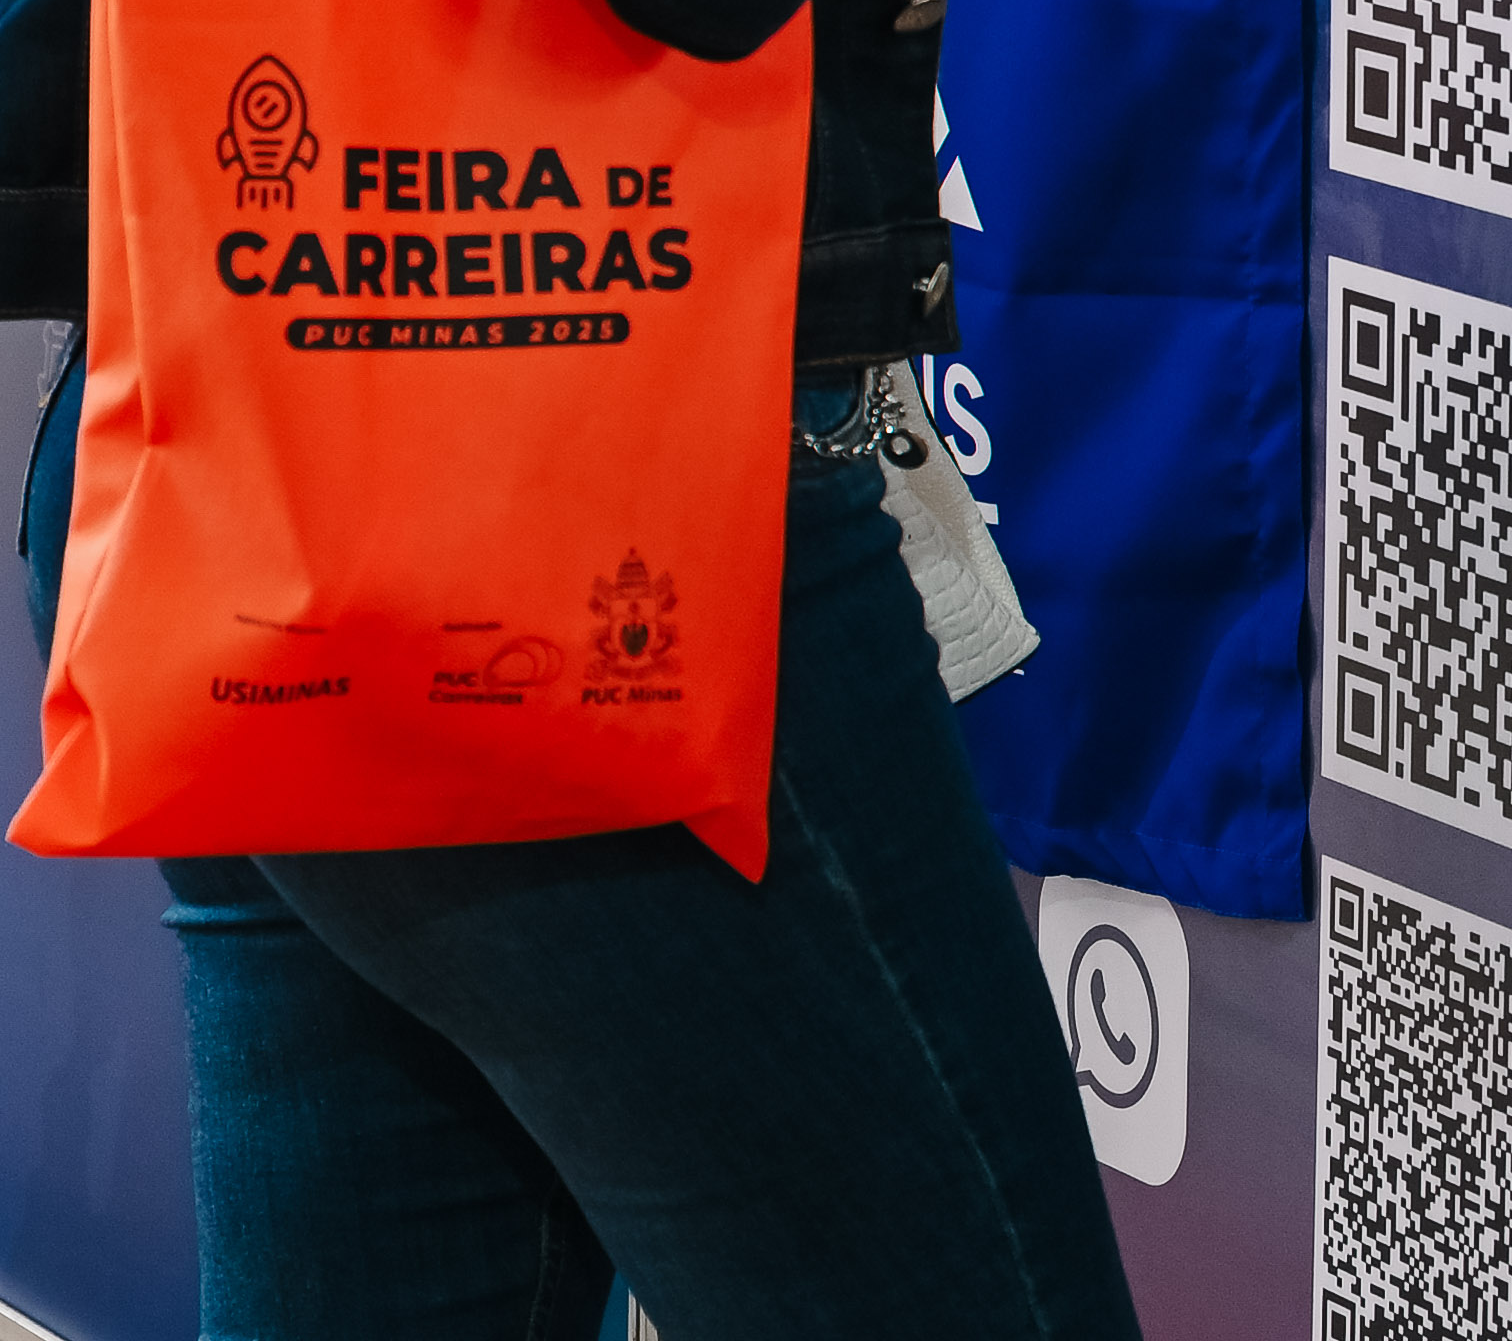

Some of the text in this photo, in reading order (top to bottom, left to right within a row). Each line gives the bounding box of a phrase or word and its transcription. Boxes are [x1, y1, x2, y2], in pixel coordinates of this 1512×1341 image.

[345, 147, 673, 212] FEIRA DE
[218, 227, 692, 297] CARREIRAS
[304, 319, 615, 347] PUC MINAS 2025
[211, 676, 351, 705] USIMINAS
[582, 687, 683, 705] PUC Minas
